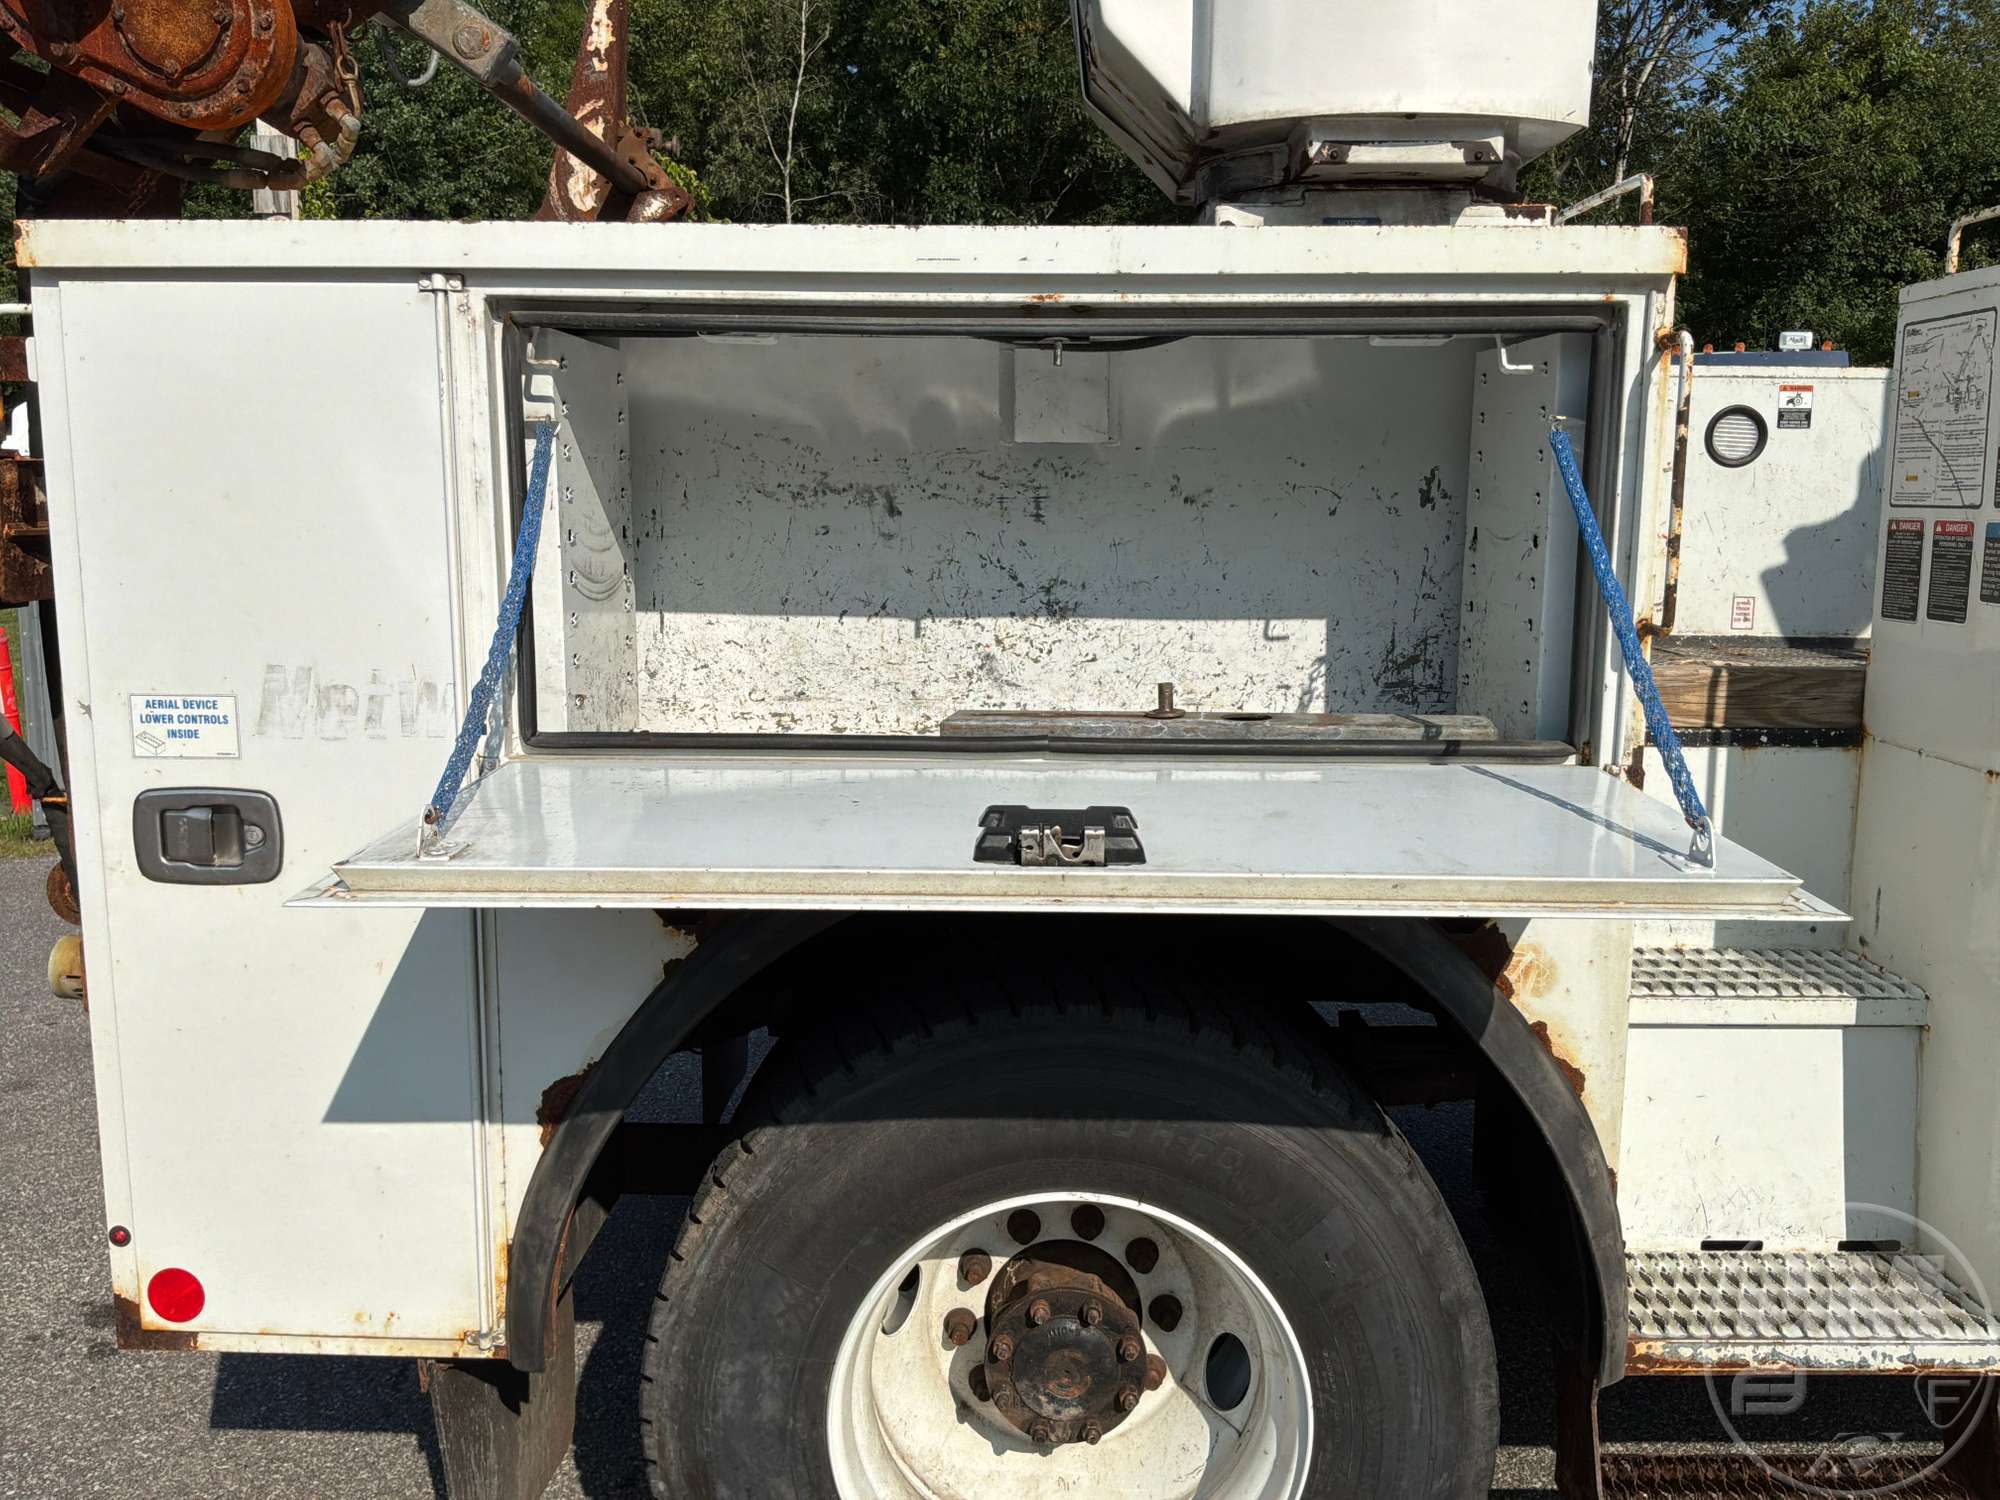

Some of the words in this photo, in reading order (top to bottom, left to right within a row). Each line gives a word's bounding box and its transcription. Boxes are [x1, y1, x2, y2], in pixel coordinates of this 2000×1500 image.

[1899, 522, 1921, 531] DANGER
[1945, 523, 1969, 533] DANGER
[145, 699, 180, 710] AERIAL
[183, 699, 219, 710] DEVICE
[140, 714, 175, 724] LOWER
[177, 714, 229, 725] CONTROLS
[167, 729, 201, 739] INSIDE
